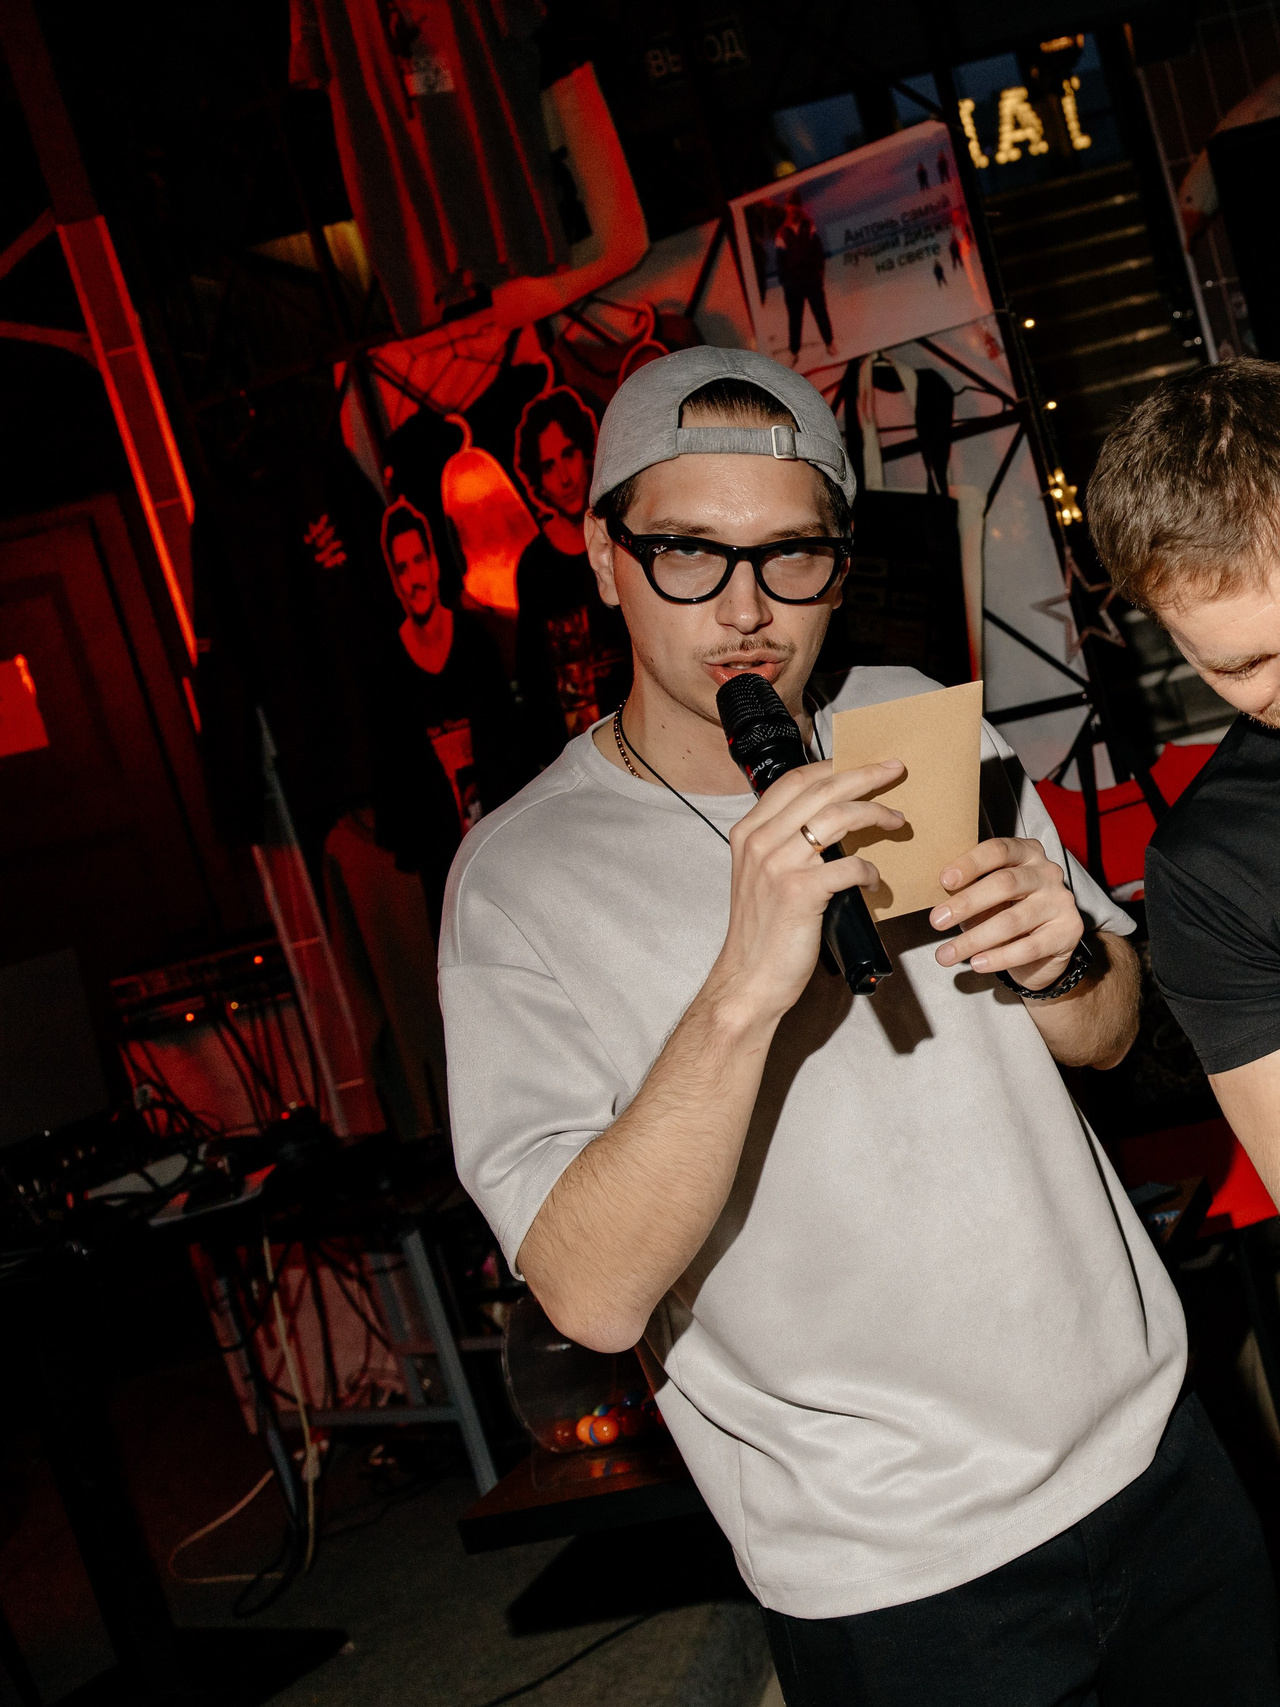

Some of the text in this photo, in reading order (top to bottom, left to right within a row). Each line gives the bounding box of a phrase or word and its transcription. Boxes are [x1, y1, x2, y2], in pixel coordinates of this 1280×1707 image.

[643, 28, 752, 78] ВЫОД
[875, 242, 941, 273] на свете
